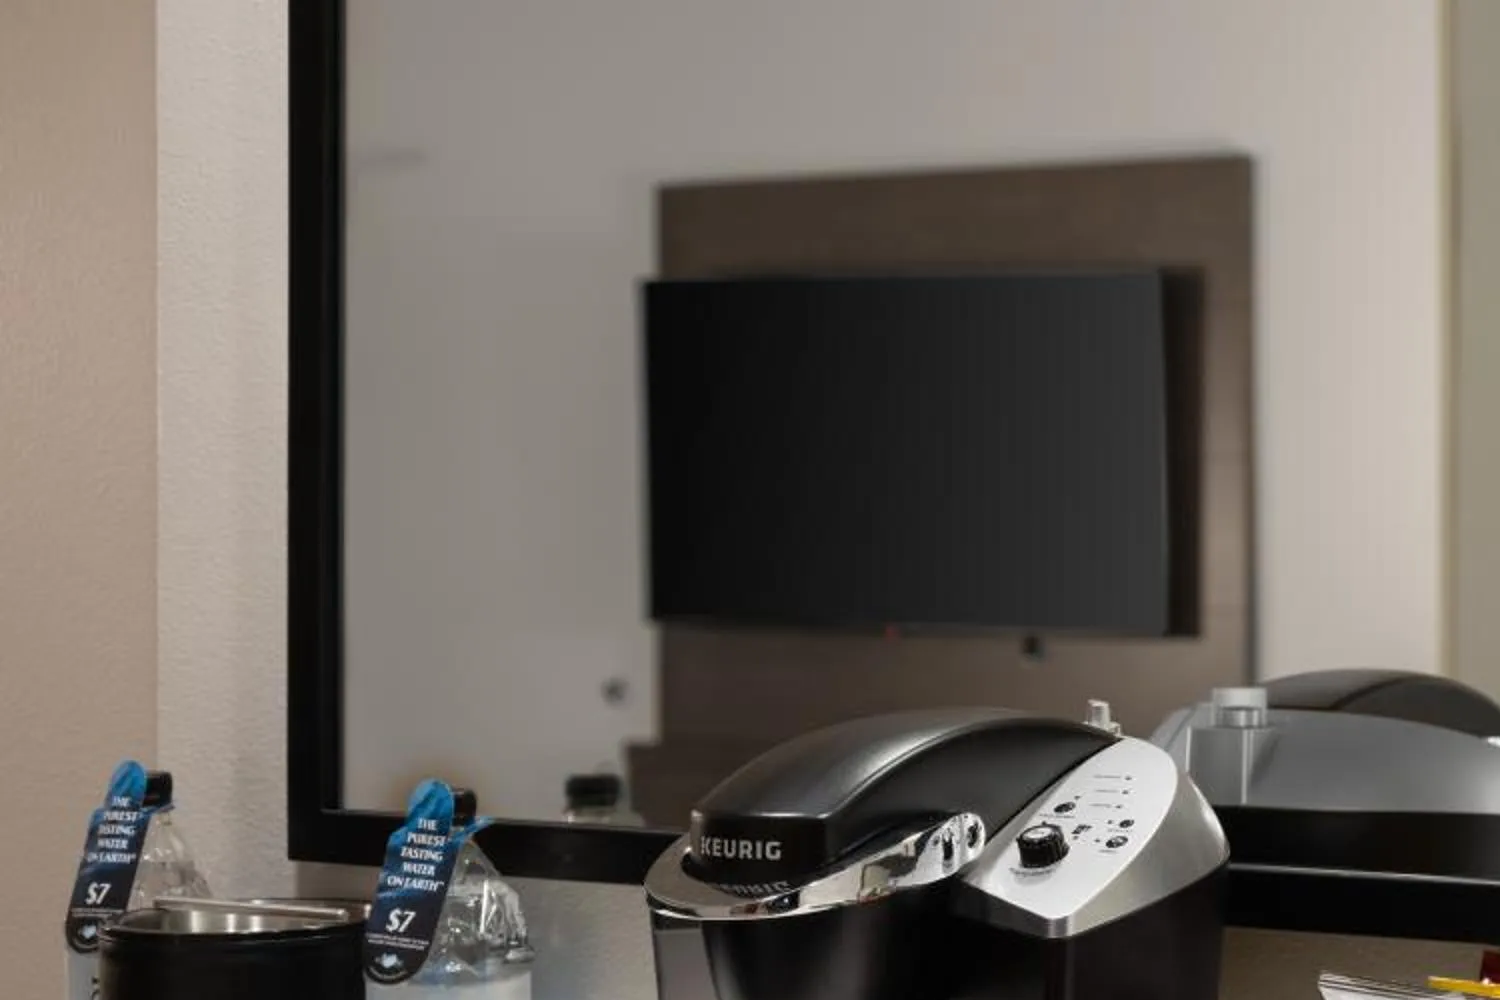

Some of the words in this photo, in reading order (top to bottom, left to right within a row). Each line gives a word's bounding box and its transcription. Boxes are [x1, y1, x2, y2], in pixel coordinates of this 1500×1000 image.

[418, 819, 438, 830] THE
[406, 832, 446, 847] PUREST
[400, 848, 444, 862] TASTING
[700, 836, 783, 860] KEURIG
[402, 862, 436, 876] WATER
[386, 874, 403, 887] ON
[85, 882, 112, 905] $7
[385, 908, 417, 932] $7
